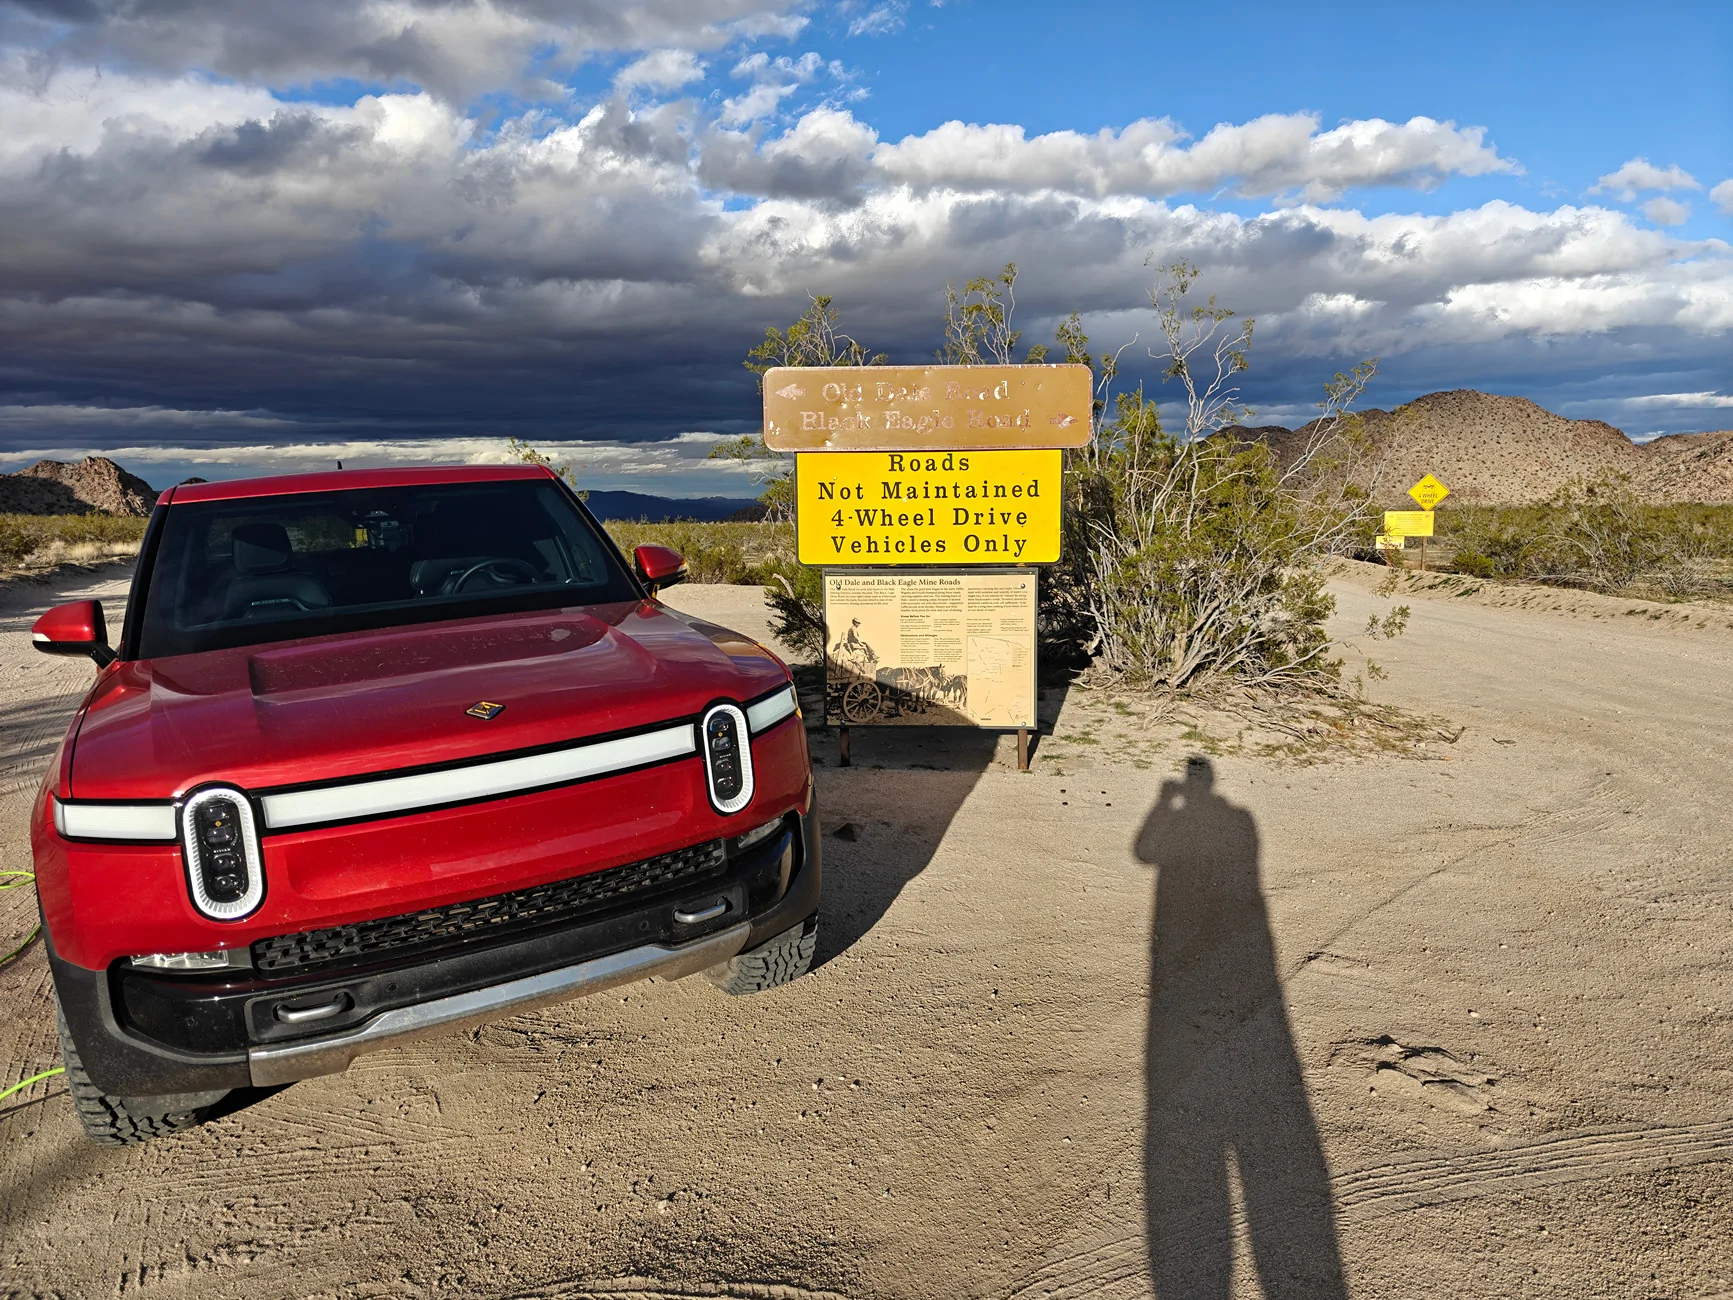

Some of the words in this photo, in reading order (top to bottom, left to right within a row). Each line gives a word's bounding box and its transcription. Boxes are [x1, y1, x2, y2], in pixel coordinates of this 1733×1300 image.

[822, 382, 864, 402] Old
[875, 381, 933, 402] Dale
[945, 380, 1010, 401] Road
[800, 410, 872, 431] Black
[883, 410, 954, 435] Eagle
[966, 408, 1030, 429] Road
[888, 453, 970, 472] Roads
[817, 482, 864, 500] Not
[881, 479, 1040, 500] Maintained
[831, 508, 936, 527] 4-Wheel
[952, 507, 1029, 526] Drive
[831, 535, 946, 554] Vehicles
[963, 534, 1028, 557] Only
[898, 579, 917, 587] Eagle
